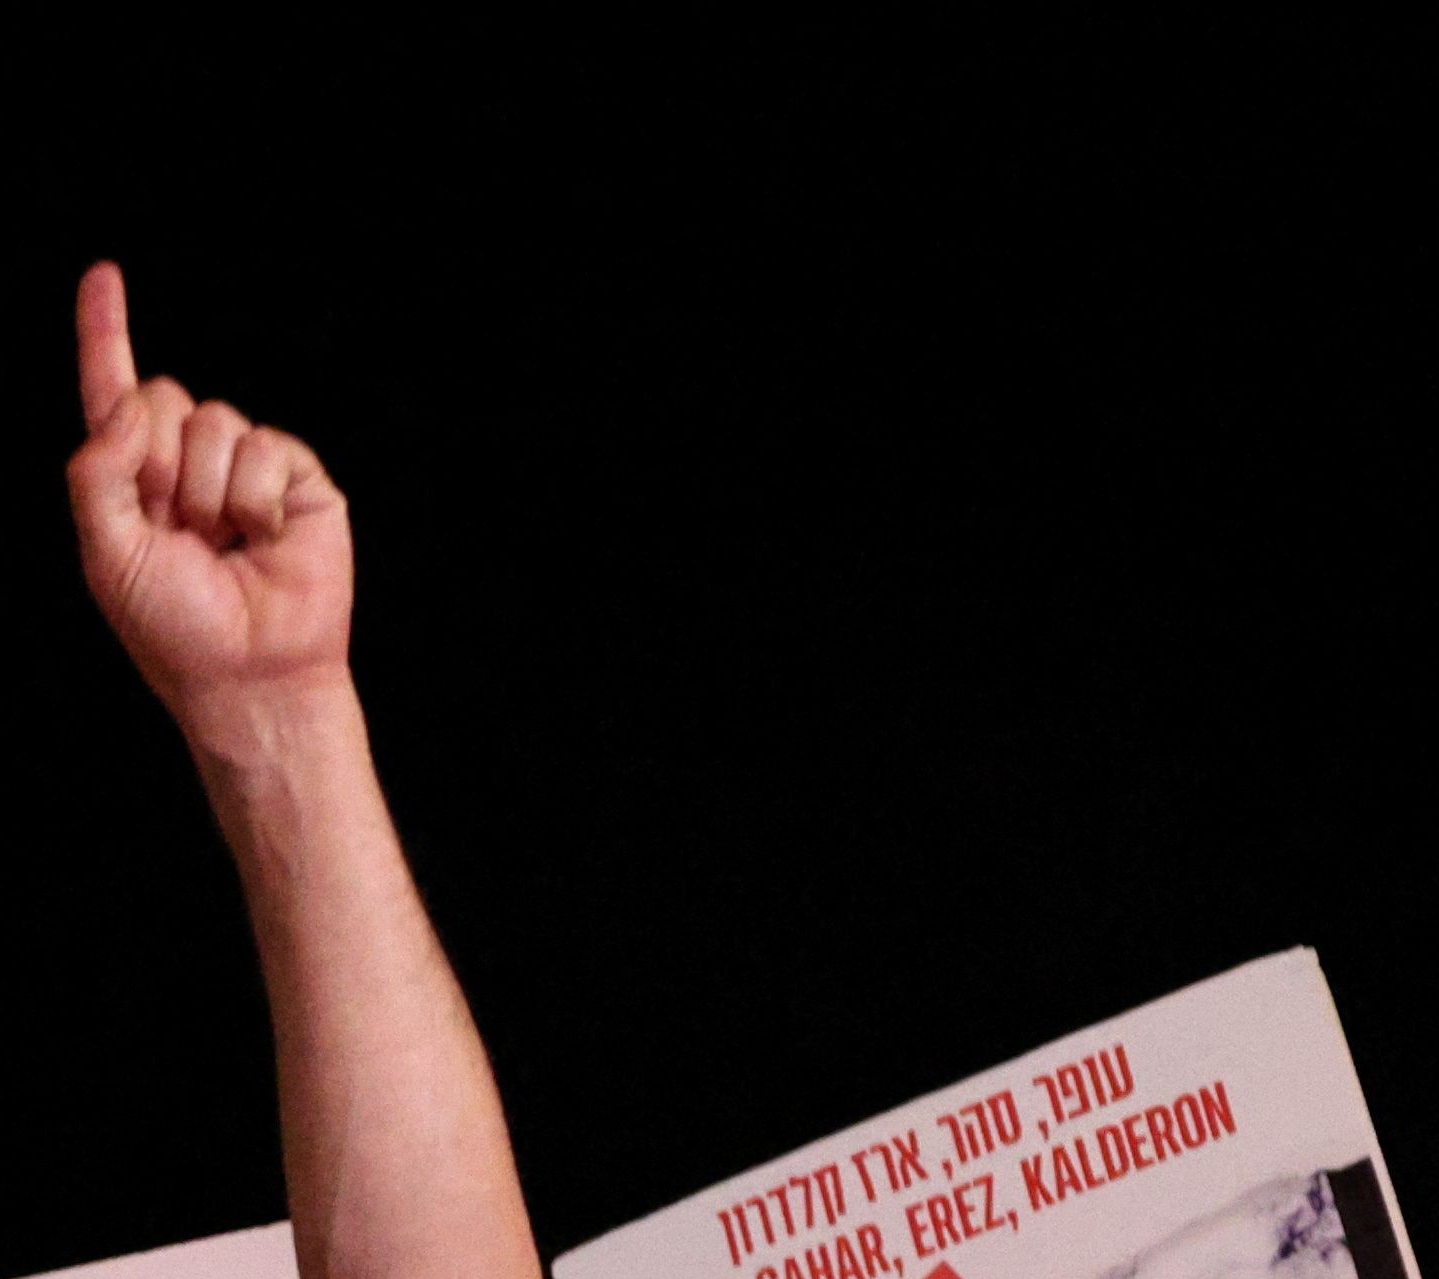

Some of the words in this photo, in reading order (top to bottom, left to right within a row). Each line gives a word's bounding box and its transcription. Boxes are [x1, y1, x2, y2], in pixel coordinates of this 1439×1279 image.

[937, 1089, 1024, 1177] סהר,
[1034, 1042, 1136, 1137] עופר,
[850, 1128, 929, 1203] ארז
[904, 1173, 1020, 1261] EREZ,
[1020, 1080, 1239, 1214] KALDERON
[717, 1162, 848, 1267] קלדרון
